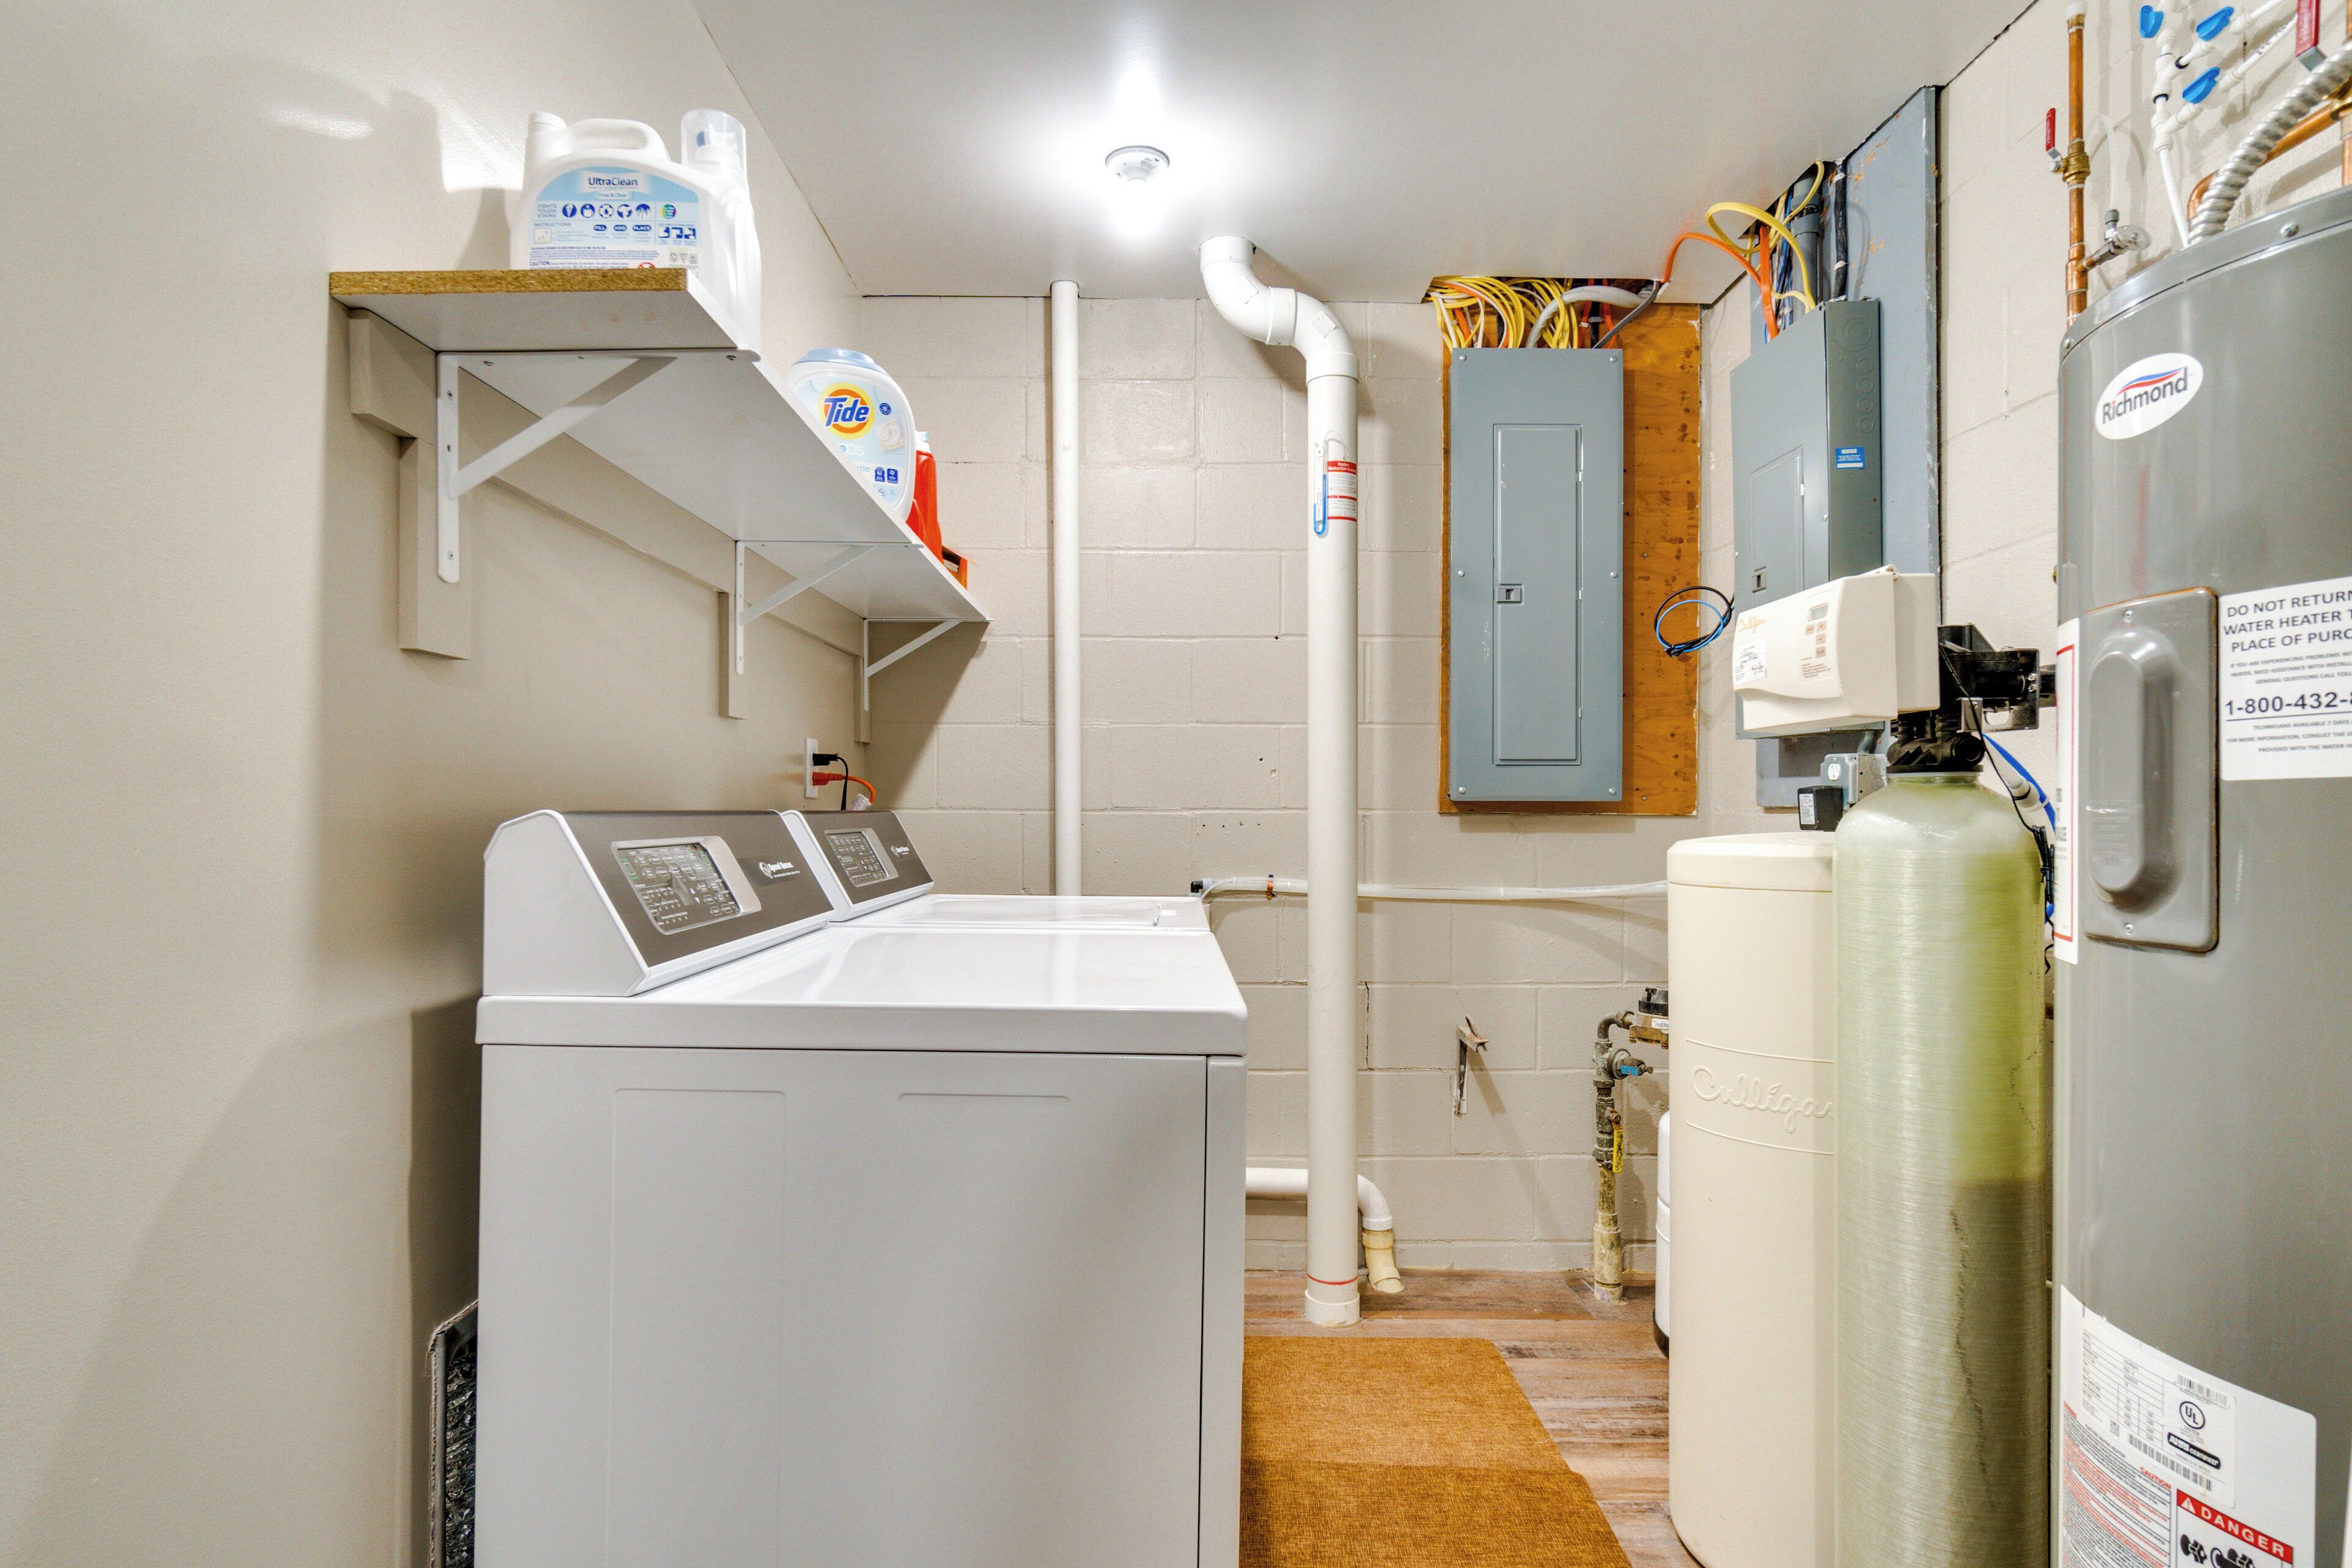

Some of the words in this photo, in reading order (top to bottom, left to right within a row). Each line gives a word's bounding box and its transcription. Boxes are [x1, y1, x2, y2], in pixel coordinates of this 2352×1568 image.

[589, 177, 638, 186] UltraClean
[2102, 366, 2188, 424] Richmond
[823, 397, 870, 426] Tide
[2228, 605, 2248, 617] DO
[2254, 599, 2286, 613] NOT
[2223, 619, 2274, 635] WATER
[2279, 611, 2342, 628] HEATER
[2231, 637, 2276, 652] PLACE
[2281, 634, 2302, 646] OF
[2225, 692, 2352, 715] 1-800-432-
[2185, 1405, 2199, 1425] UL
[2140, 1466, 2171, 1490] CAUTION
[2201, 1506, 2284, 1558] DANGER
